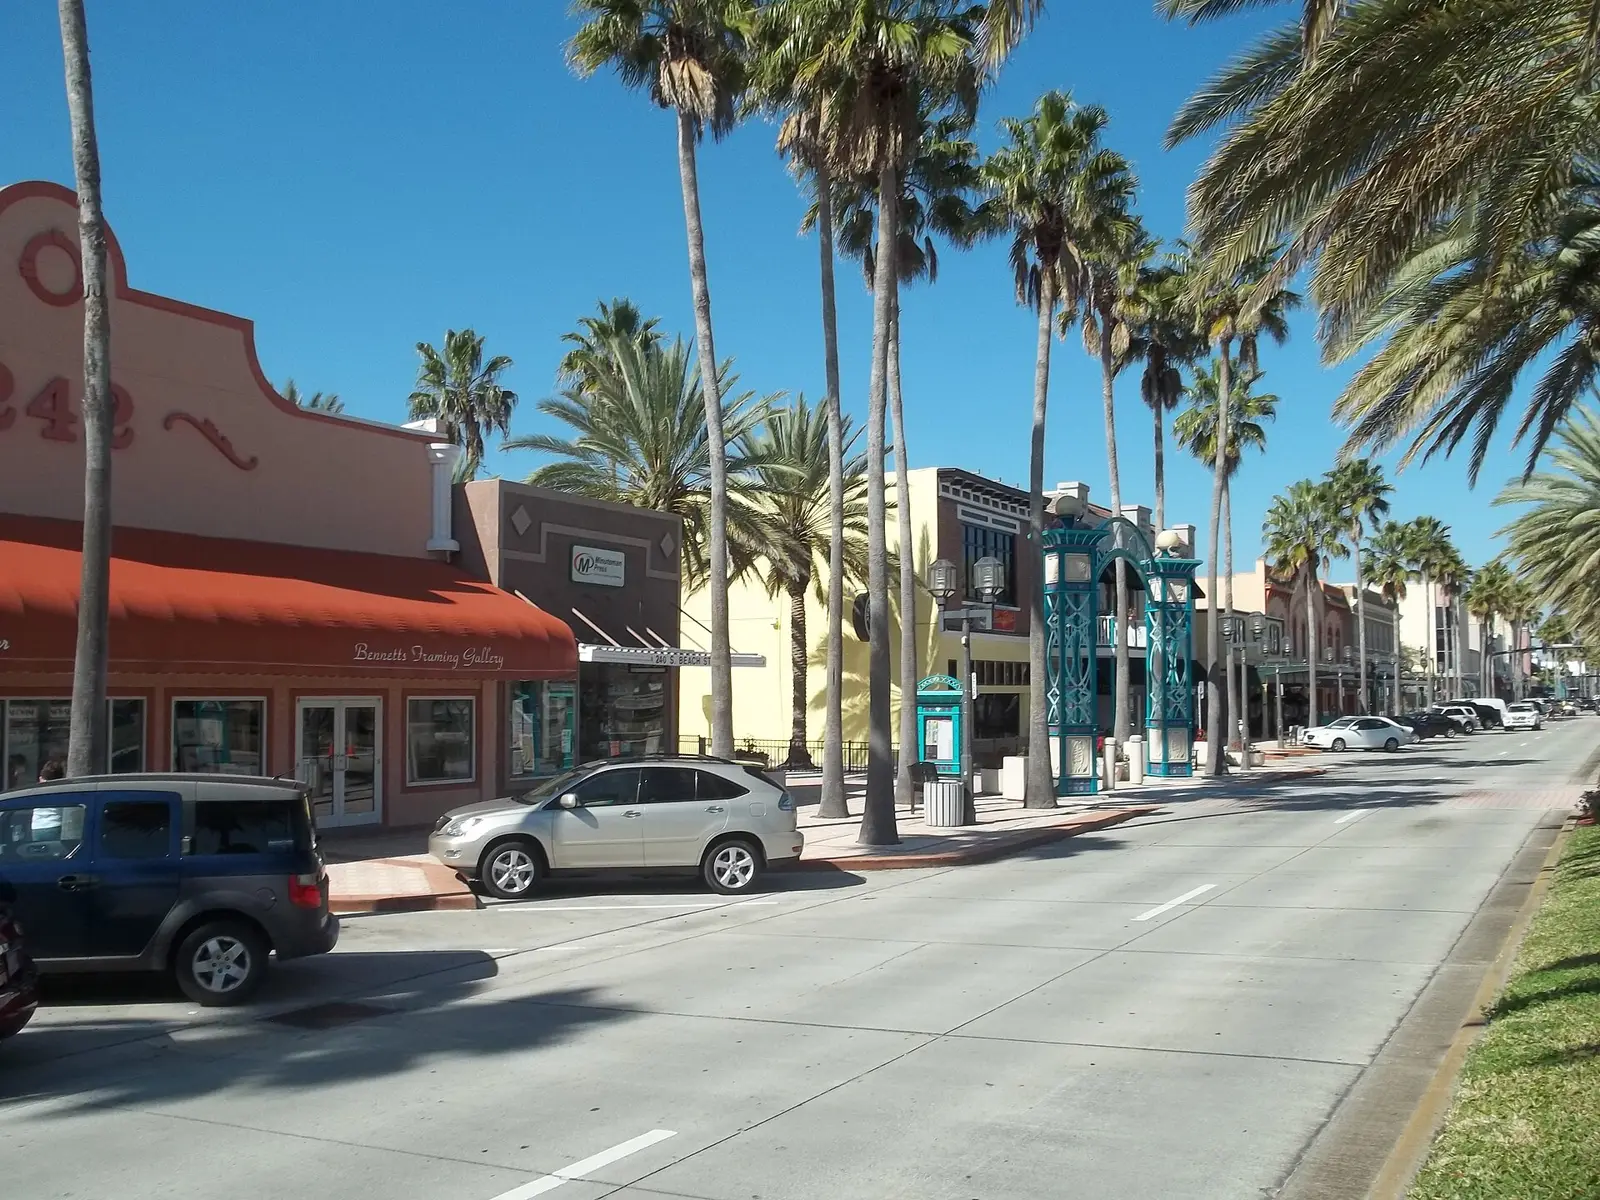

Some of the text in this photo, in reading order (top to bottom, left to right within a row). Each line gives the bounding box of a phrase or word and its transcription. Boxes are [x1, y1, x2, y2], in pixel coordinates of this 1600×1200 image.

[595, 556, 622, 567] Minuteman
[593, 564, 608, 573] Press
[353, 642, 504, 670] Bennetts Framing Gallery
[655, 655, 667, 664] 240
[679, 656, 701, 665] BEACH
